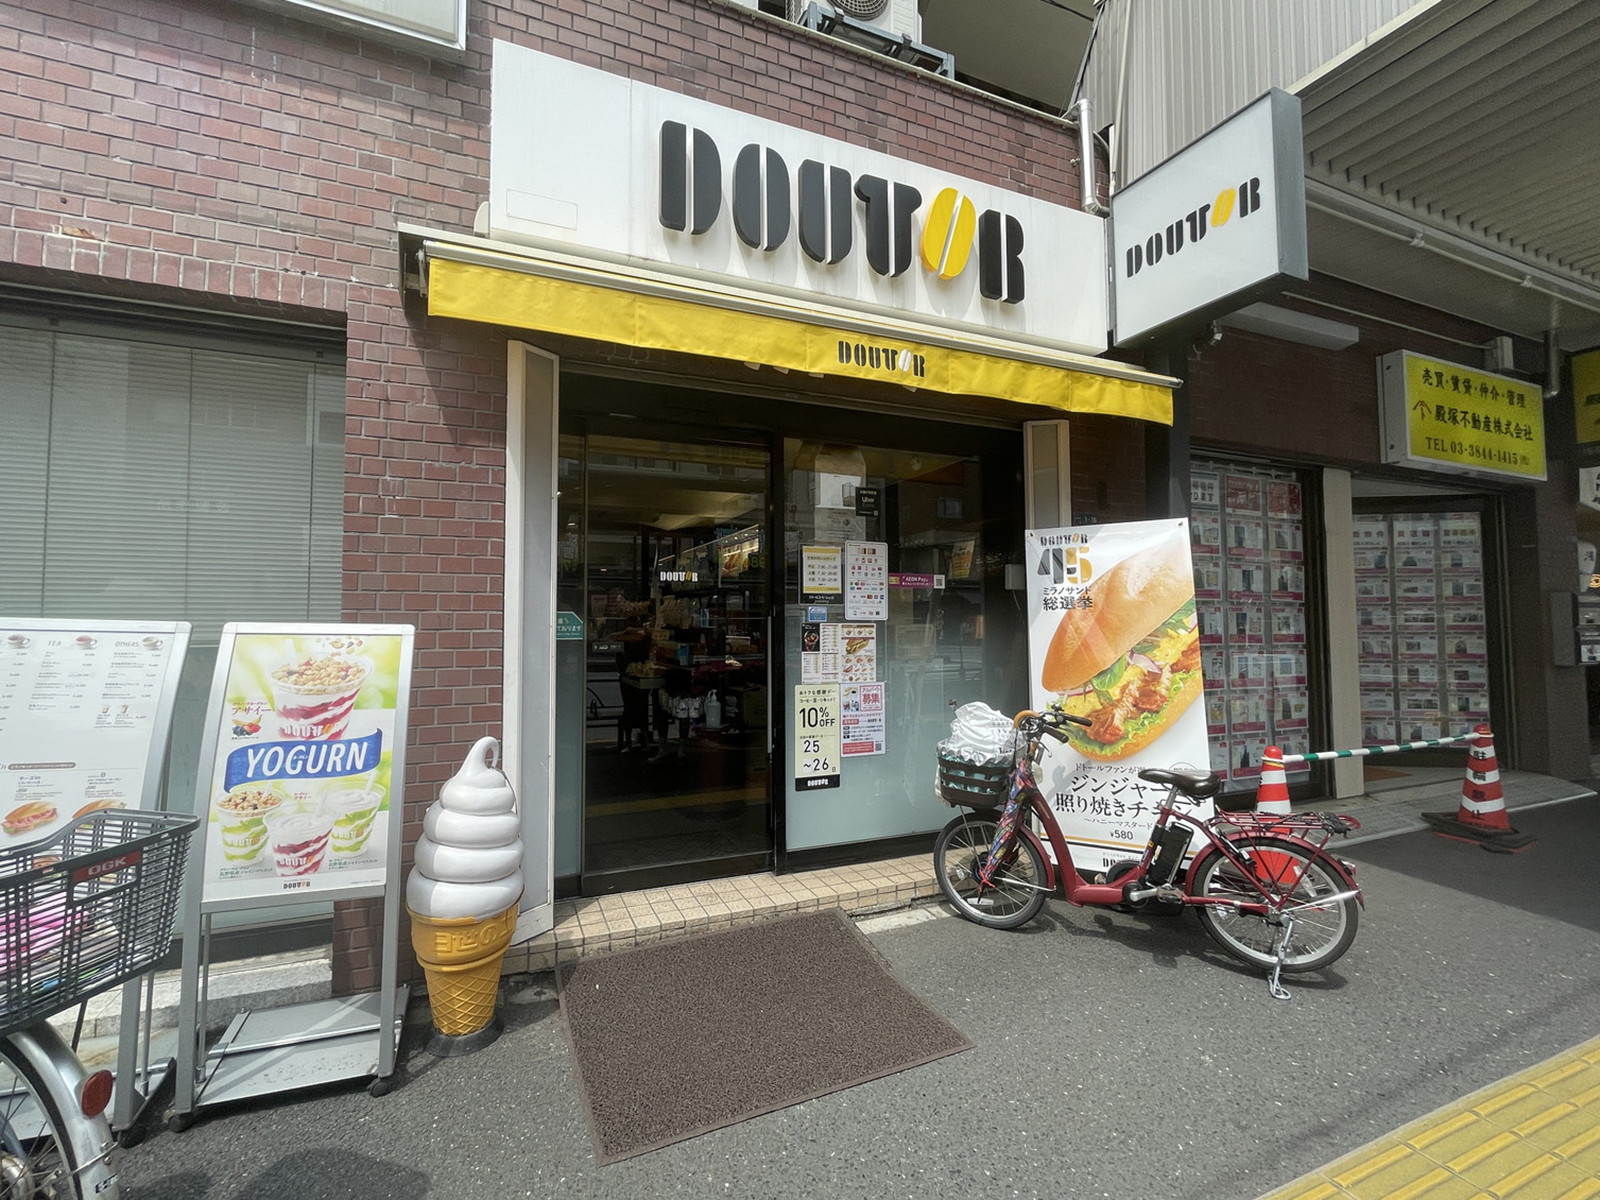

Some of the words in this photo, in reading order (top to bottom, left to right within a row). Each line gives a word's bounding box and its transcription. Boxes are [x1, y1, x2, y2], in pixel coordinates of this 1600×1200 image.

[658, 120, 1025, 305] DOUTOR
[1126, 177, 1261, 278] DOUTOR
[838, 341, 925, 378] DOUTOR
[1434, 404, 1534, 441] 殿塚不動産株式会社
[1426, 436, 1447, 452] TEL
[1450, 441, 1519, 466] 03-3844-1415
[1040, 532, 1088, 547] DOUTOR
[1037, 546, 1092, 584] 45
[659, 571, 698, 582] DOUTOR
[1042, 586, 1092, 596] ミラノサンド
[1042, 596, 1093, 611] 総選挙
[862, 693, 880, 704] 募集
[232, 706, 272, 716] アサイー
[799, 707, 829, 728] 10%
[819, 718, 836, 727] OFF
[803, 739, 820, 753] 25
[247, 742, 368, 778] YOGURN
[1071, 774, 1171, 799] ジンジャー
[1110, 830, 1134, 840] ¥580
[88, 856, 127, 876] OGK
[283, 879, 311, 889] DOUTOR
